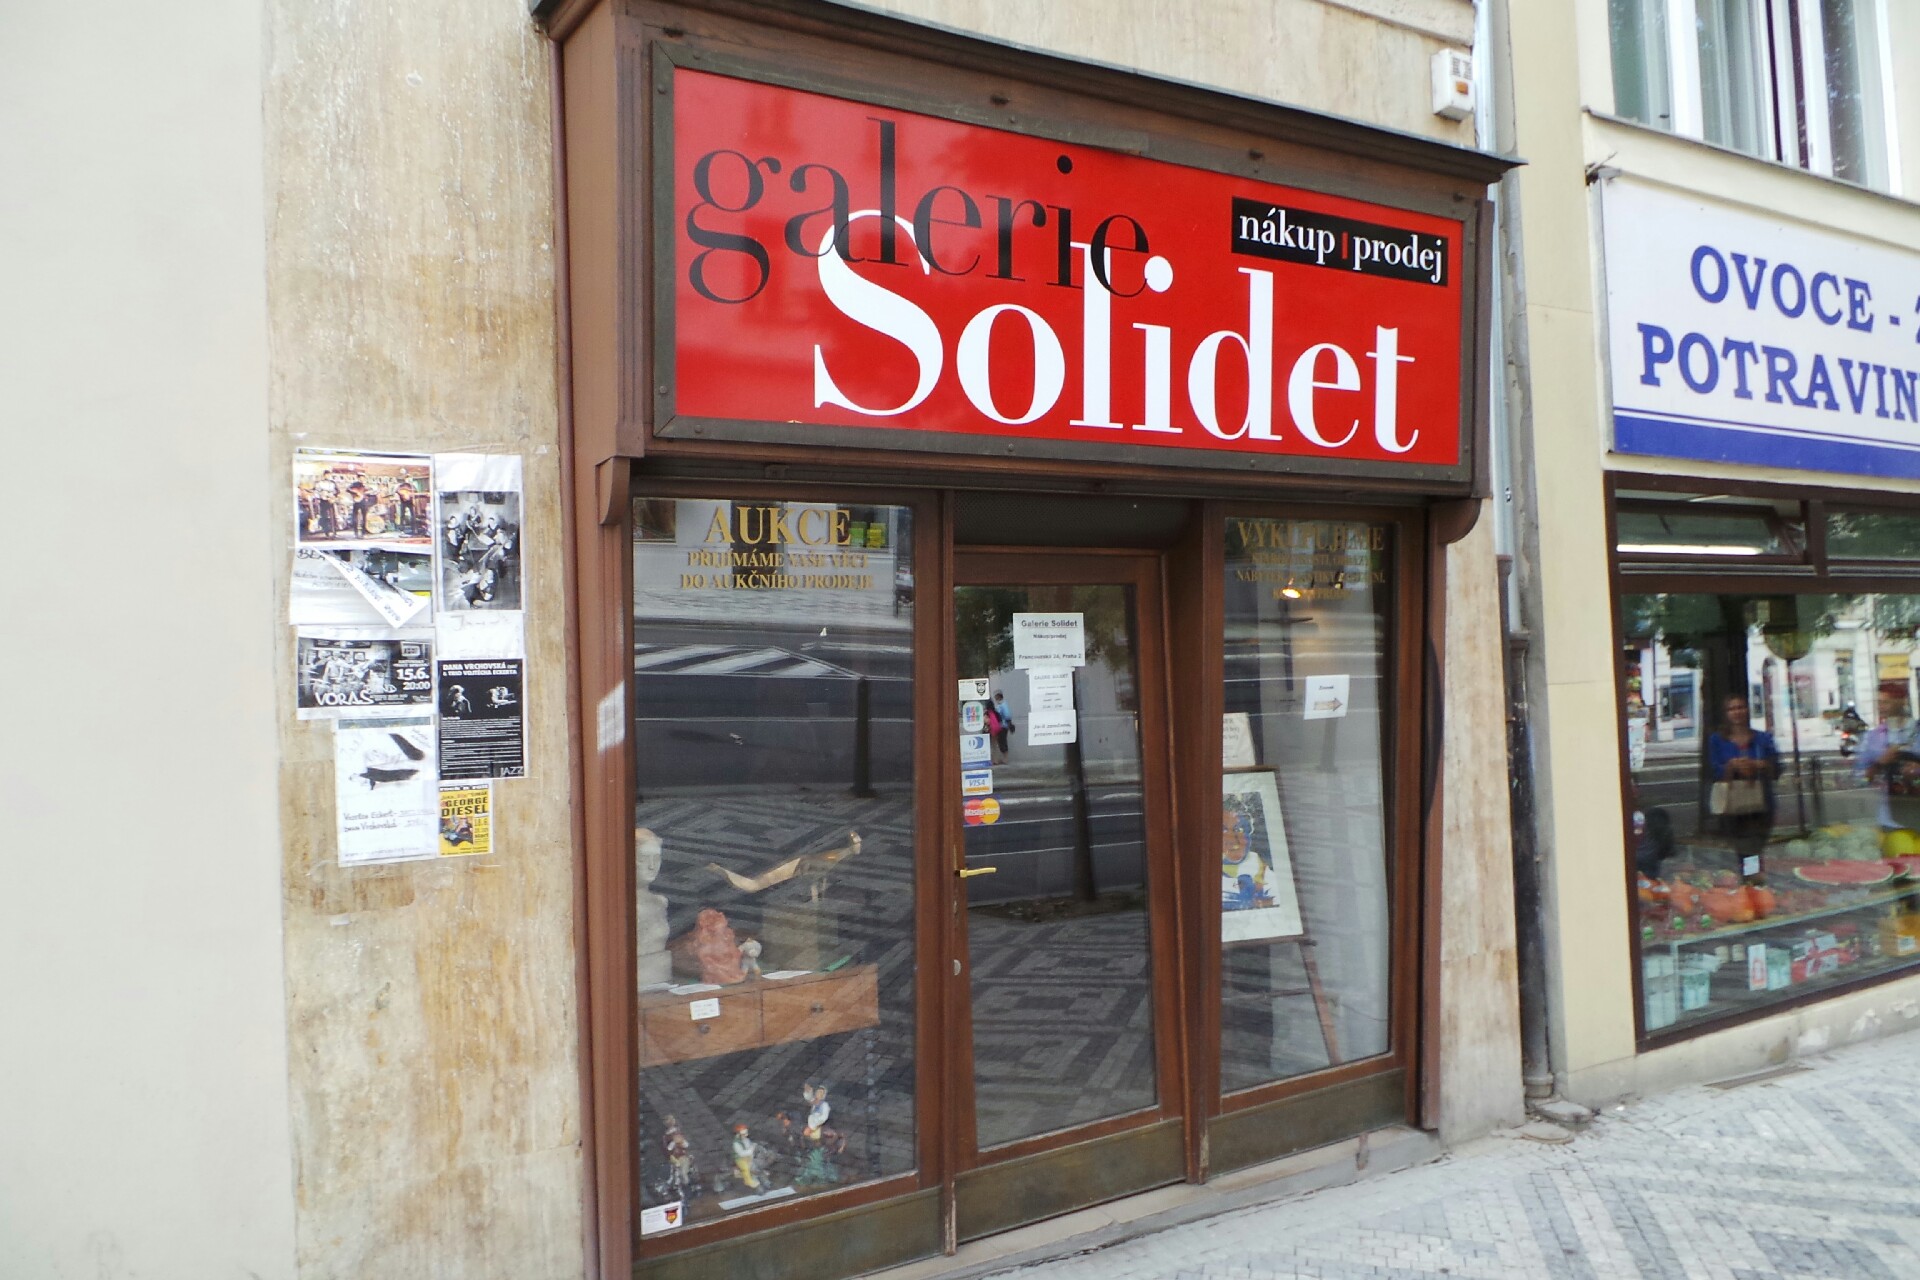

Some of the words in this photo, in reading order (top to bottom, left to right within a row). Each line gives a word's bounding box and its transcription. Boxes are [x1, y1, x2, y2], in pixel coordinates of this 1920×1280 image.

[686, 118, 1150, 304] galerie
[1239, 207, 1336, 265] nákup
[1352, 234, 1443, 284] prodej
[1690, 244, 1874, 333] OVOCE
[813, 208, 1419, 453] Solidet
[703, 505, 851, 546] AUKCE
[680, 573, 706, 590] DO
[1021, 619, 1049, 628] Galerie
[1051, 619, 1078, 628] Solidet
[396, 667, 430, 681] 15.6.
[402, 681, 431, 691] 20:00
[500, 766, 524, 777] JAZZ
[968, 779, 986, 787] VISA
[446, 797, 488, 807] GEORGE
[441, 804, 489, 817] DIESEL
